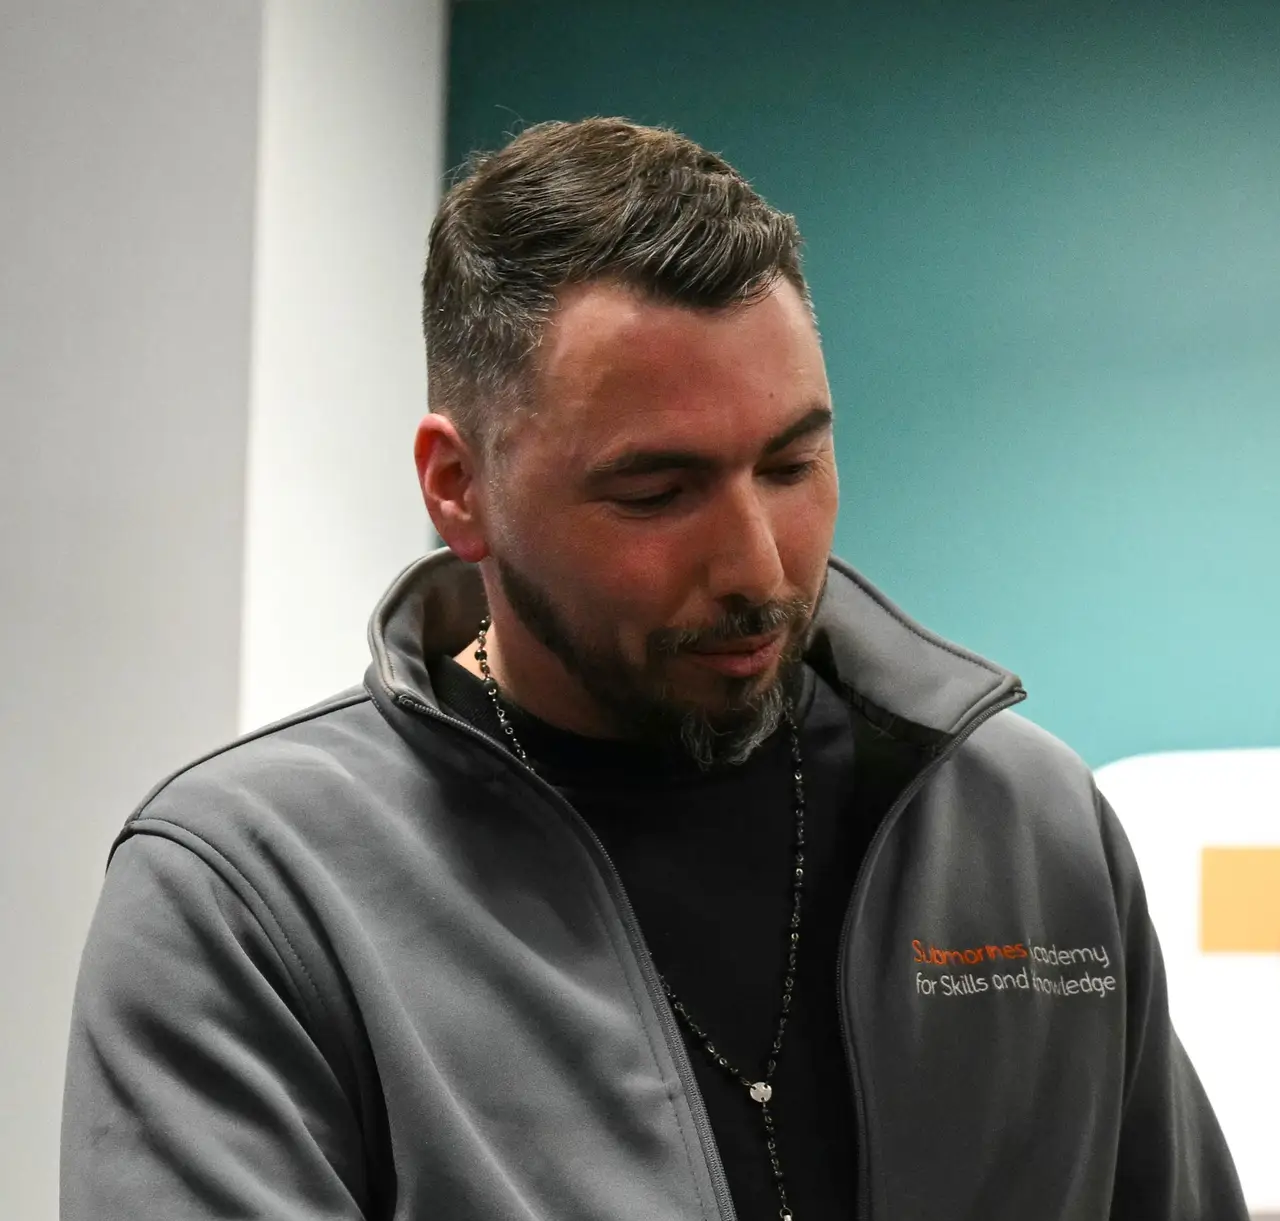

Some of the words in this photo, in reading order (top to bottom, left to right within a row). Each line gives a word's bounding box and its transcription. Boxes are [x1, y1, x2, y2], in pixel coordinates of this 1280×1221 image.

[916, 972, 937, 995] for
[940, 973, 988, 996] Skills
[992, 966, 1029, 990] and
